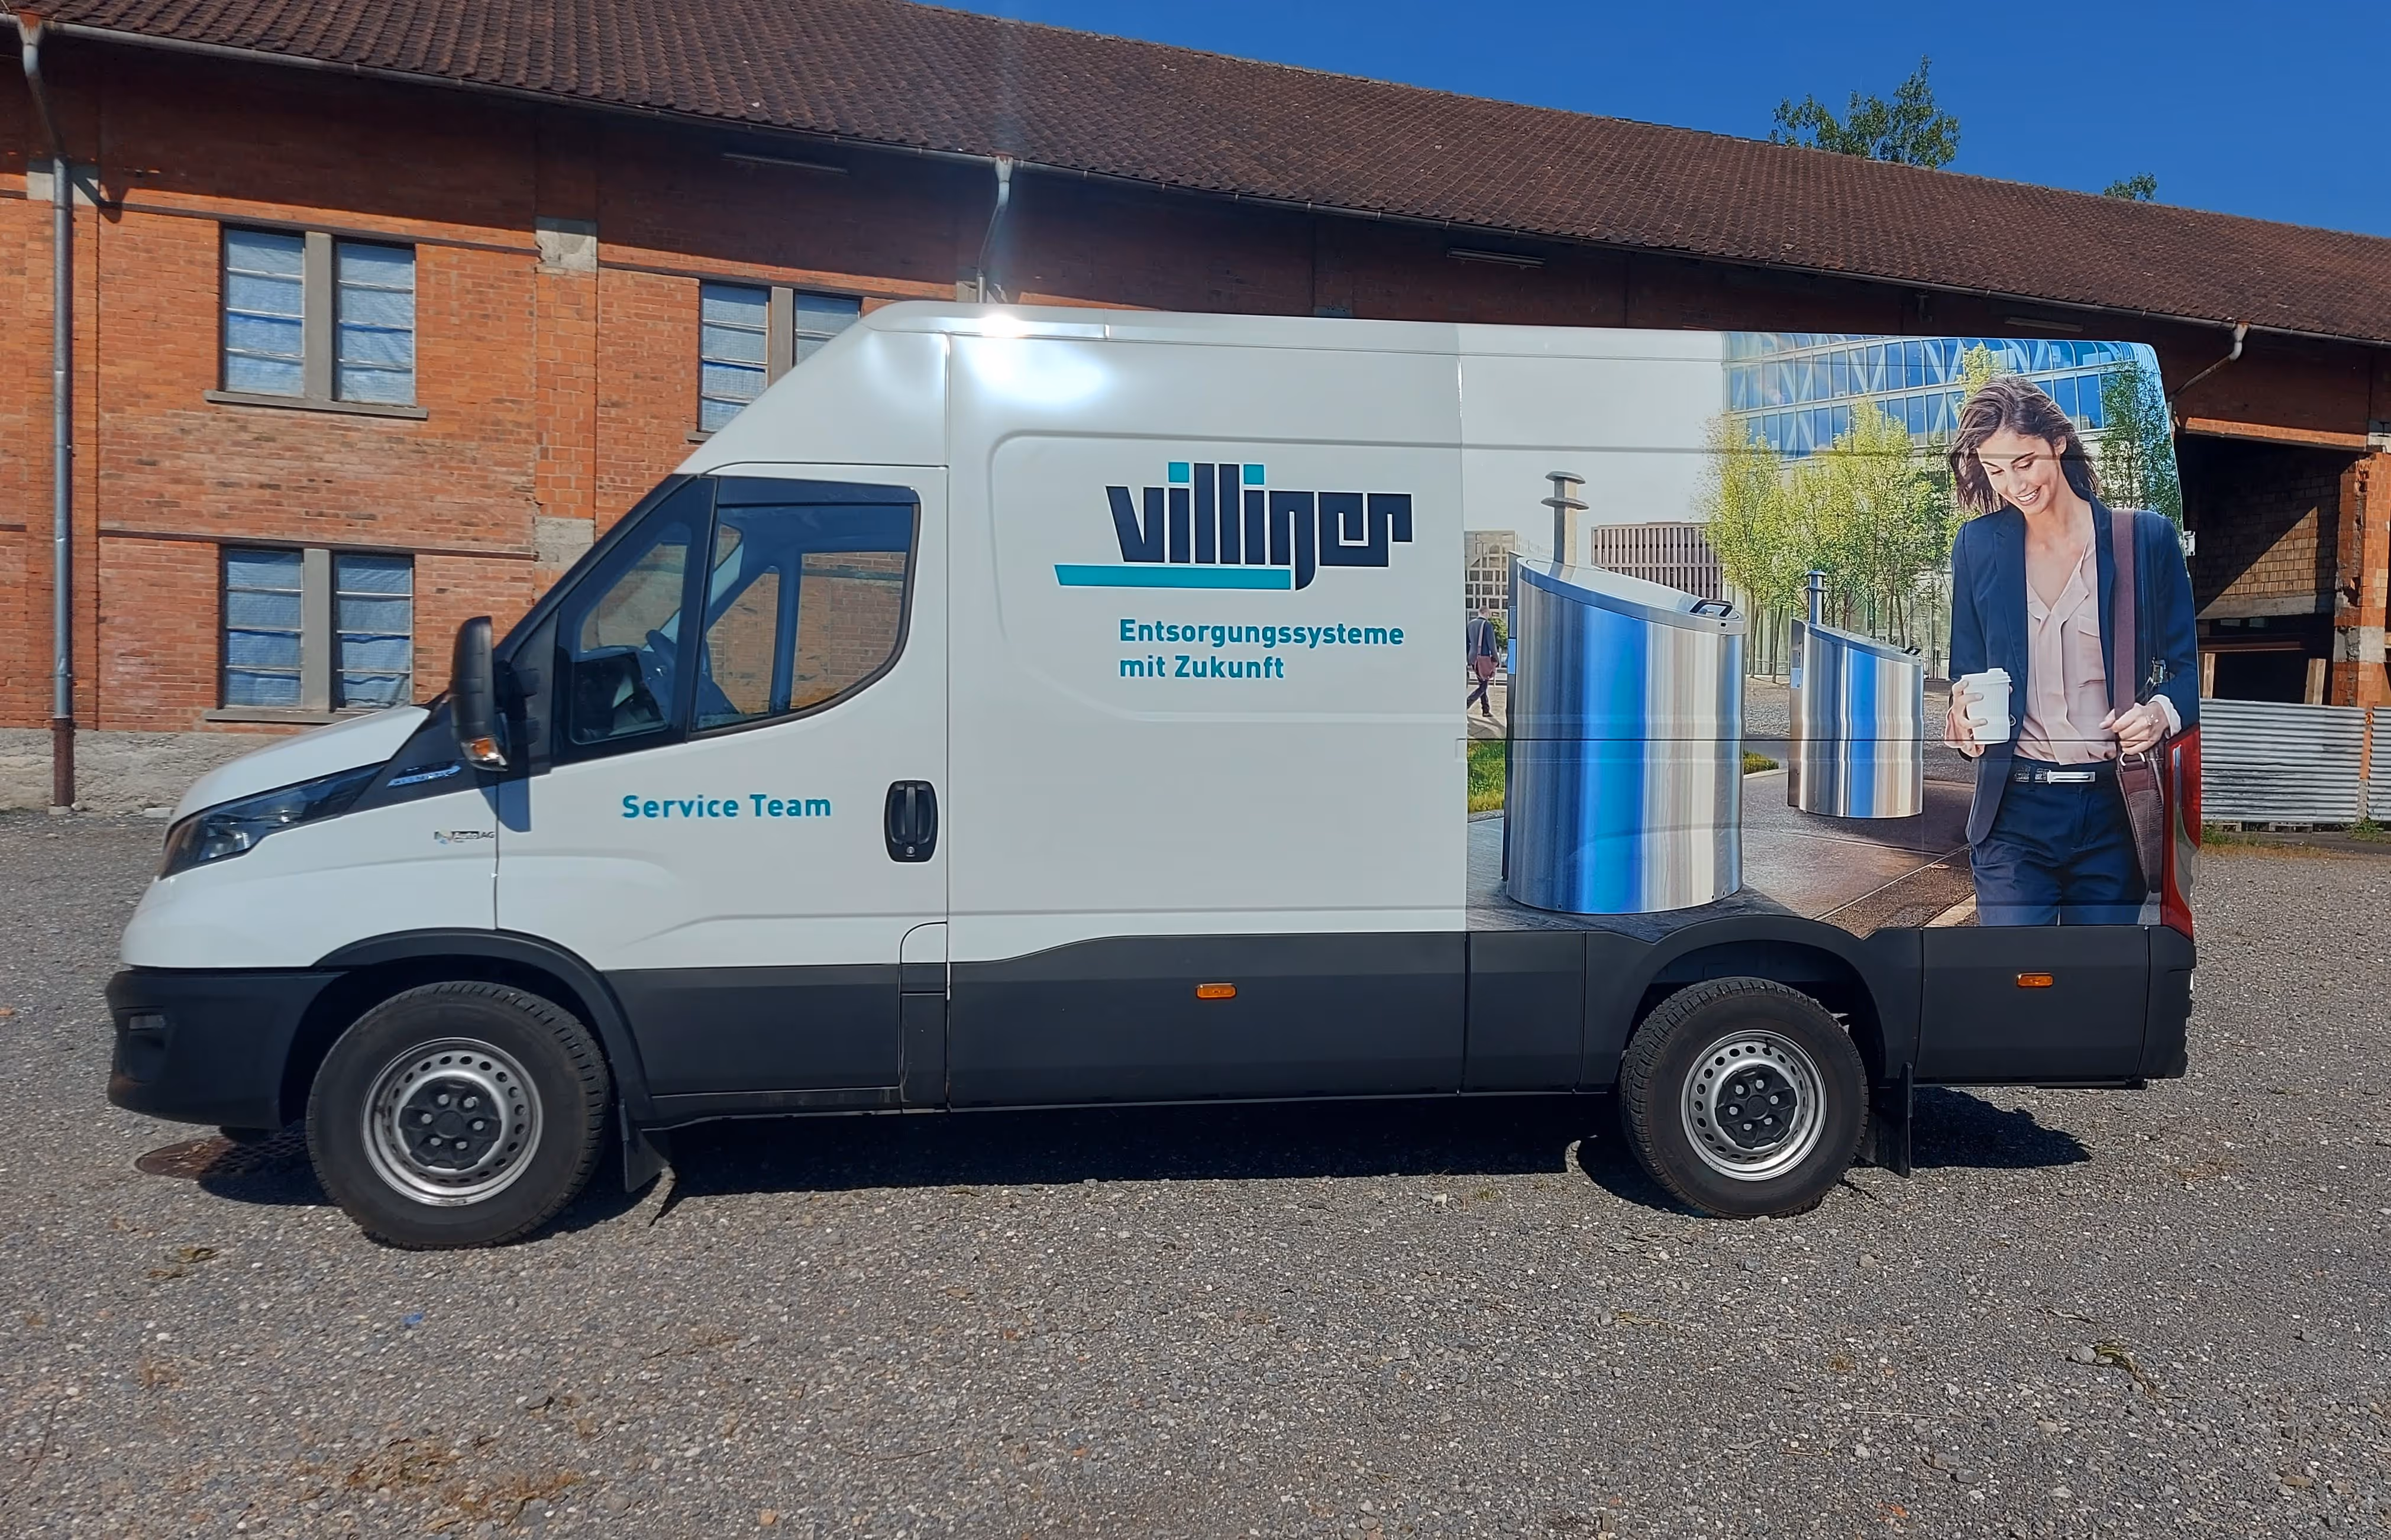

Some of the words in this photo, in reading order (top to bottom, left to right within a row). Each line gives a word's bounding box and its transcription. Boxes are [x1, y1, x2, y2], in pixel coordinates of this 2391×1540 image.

[1106, 461, 1413, 591] villiger
[1119, 618, 1404, 649] Entsorgungssysteme
[1119, 655, 1166, 678] mit
[1174, 655, 1284, 678] Zukunft
[621, 794, 739, 819] Service
[749, 794, 831, 818] Team
